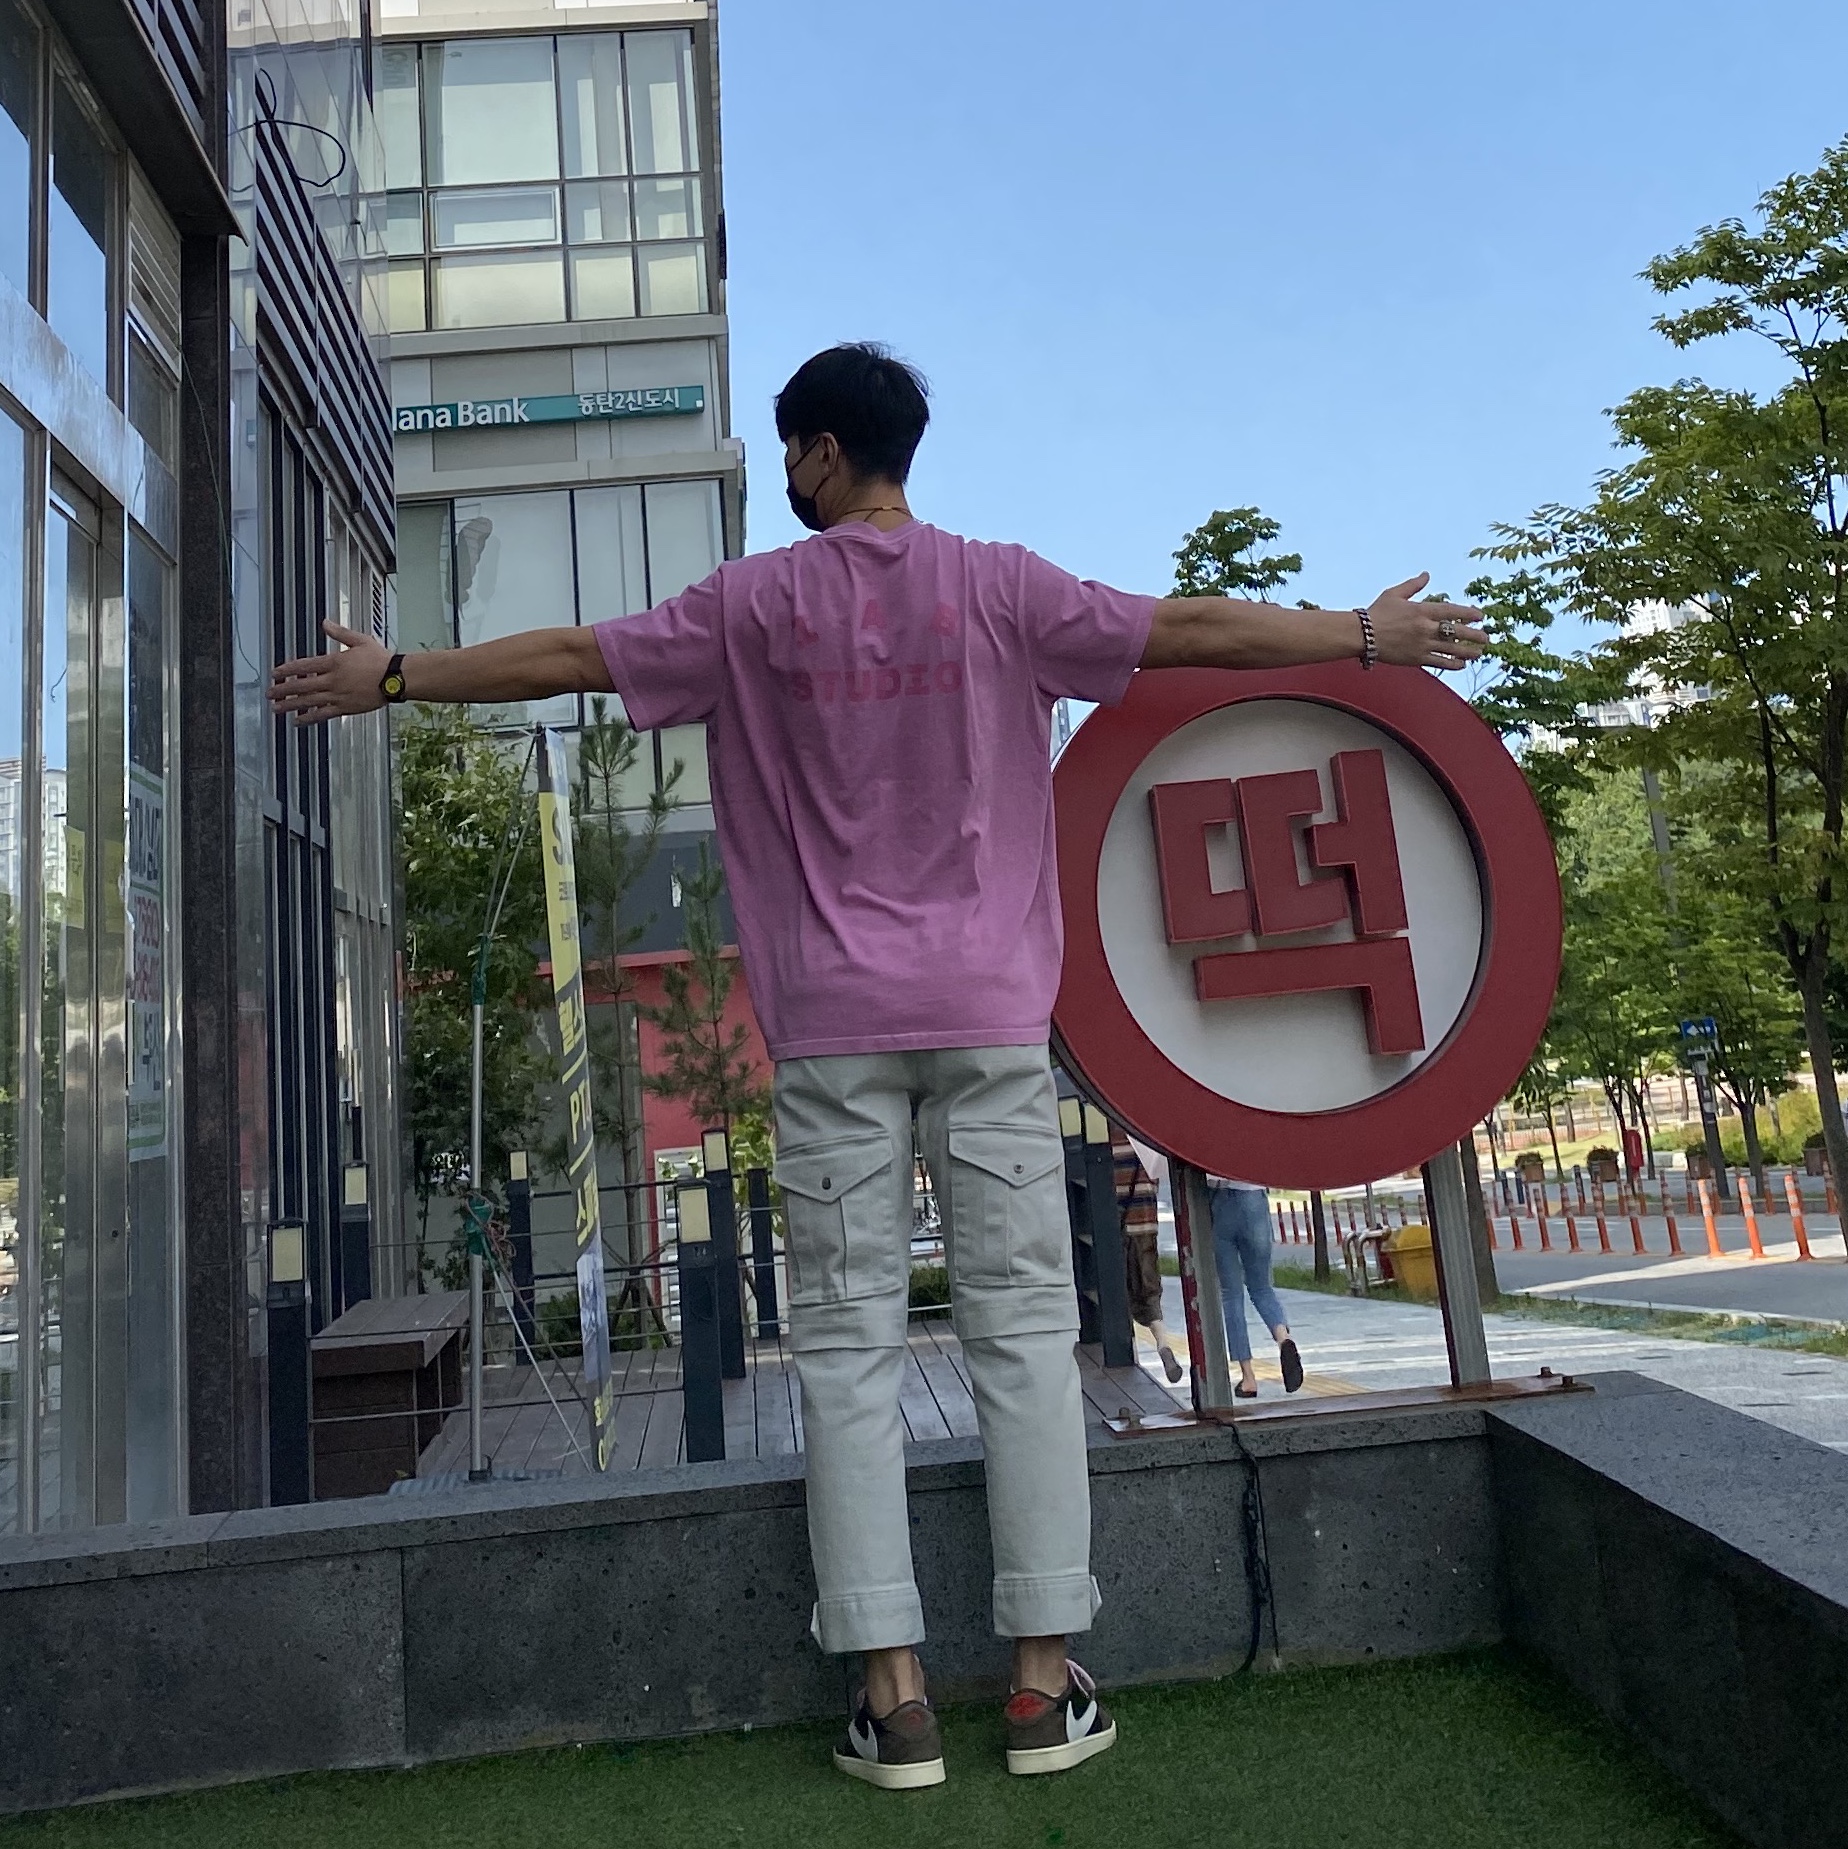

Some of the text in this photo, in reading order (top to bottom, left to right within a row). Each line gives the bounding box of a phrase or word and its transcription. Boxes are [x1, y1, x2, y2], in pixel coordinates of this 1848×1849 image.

[457, 397, 531, 427] Bank
[577, 387, 681, 416] 동탄2신도시
[791, 660, 963, 702] STUDIO
[1147, 748, 1427, 1056] 떡
